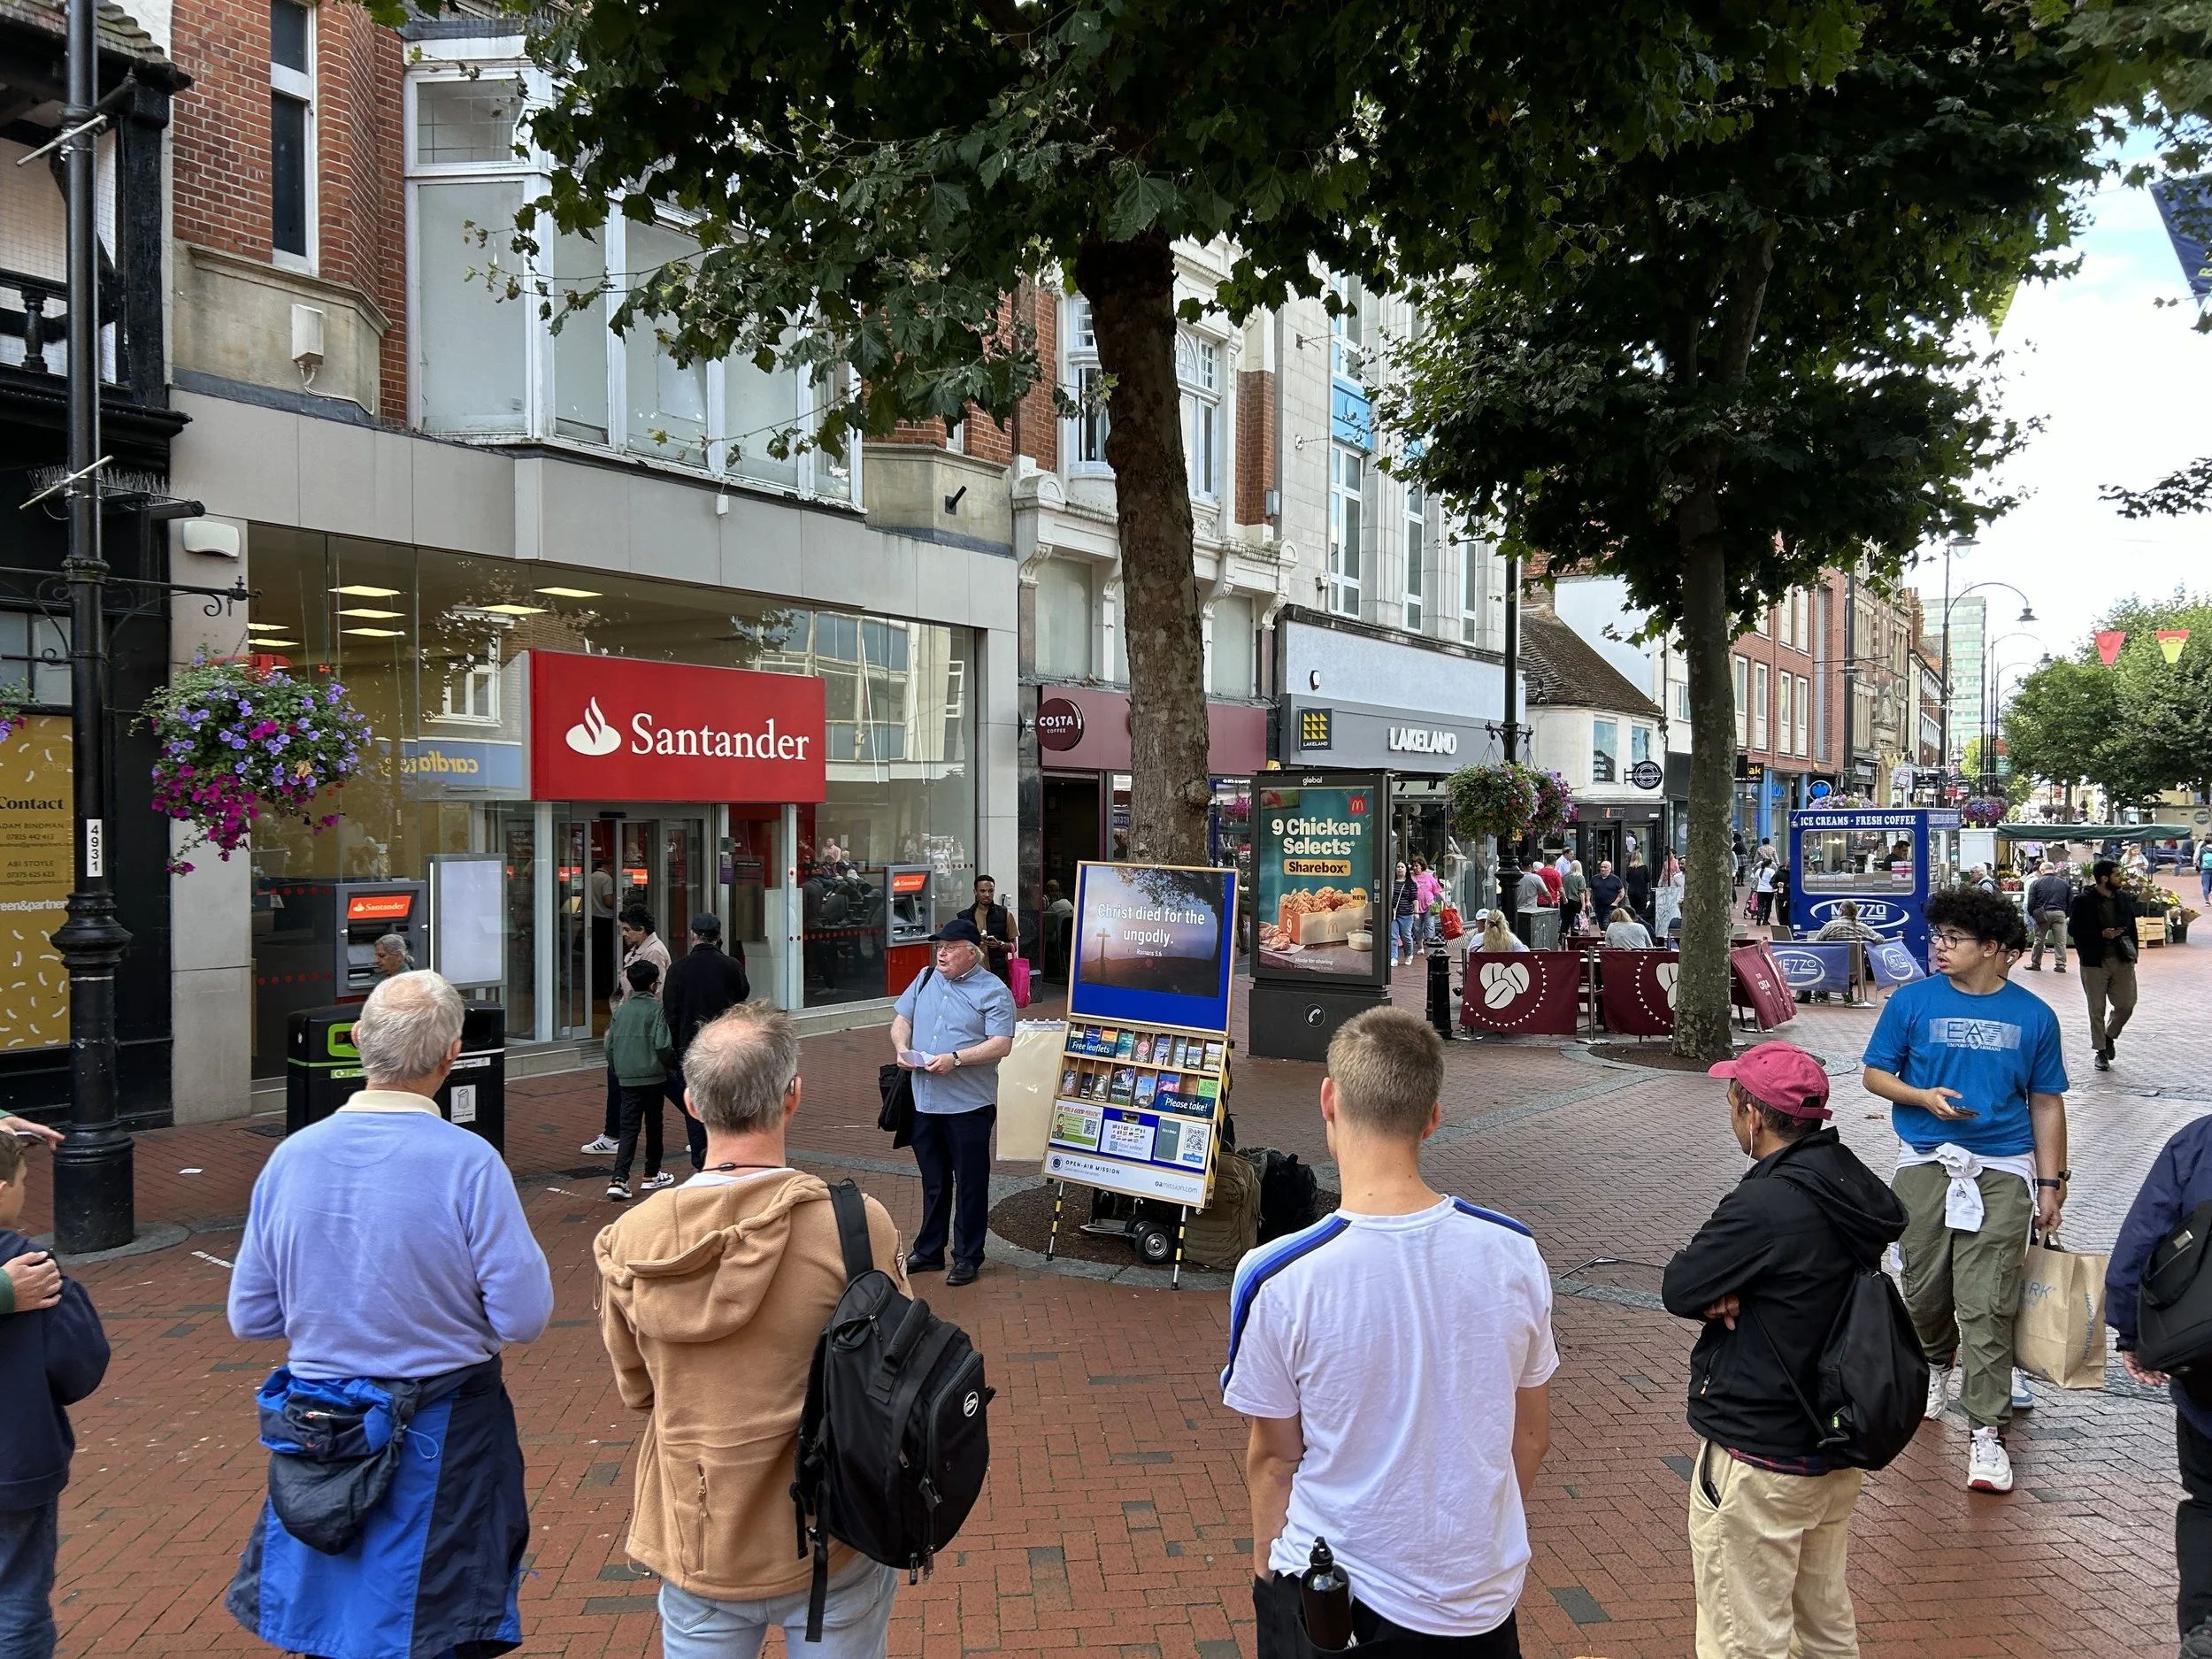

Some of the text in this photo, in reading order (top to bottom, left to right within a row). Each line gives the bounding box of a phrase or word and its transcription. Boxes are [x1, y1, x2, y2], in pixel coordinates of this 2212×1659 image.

[1039, 715, 1074, 727] COSTA
[631, 712, 810, 761] Santander
[1389, 726, 1457, 755] LAKELAND
[1302, 776, 1323, 786] global
[0, 796, 65, 810] Contact
[1271, 817, 1362, 836] 9 Chicken
[1800, 816, 1814, 826] ICE
[1816, 816, 1849, 826] CREAMS
[1855, 815, 1883, 826] FRESH
[1884, 815, 1916, 826] COFFEE
[90, 825, 99, 872] 4931
[0, 899, 70, 912] een&partner
[365, 902, 405, 911] Santander
[1831, 903, 1887, 921] MZZO
[1097, 903, 1205, 926] Christ died for the
[1123, 928, 1174, 948] ungodly.
[1947, 1021, 2002, 1042] EA7
[1071, 1041, 1110, 1054] Free leaflets
[1164, 1097, 1208, 1112] Please take!
[1065, 1159, 1094, 1171] OPEN-AIR
[1095, 1165, 1120, 1176] MISSION
[1154, 1180, 1198, 1194] oamission.com
